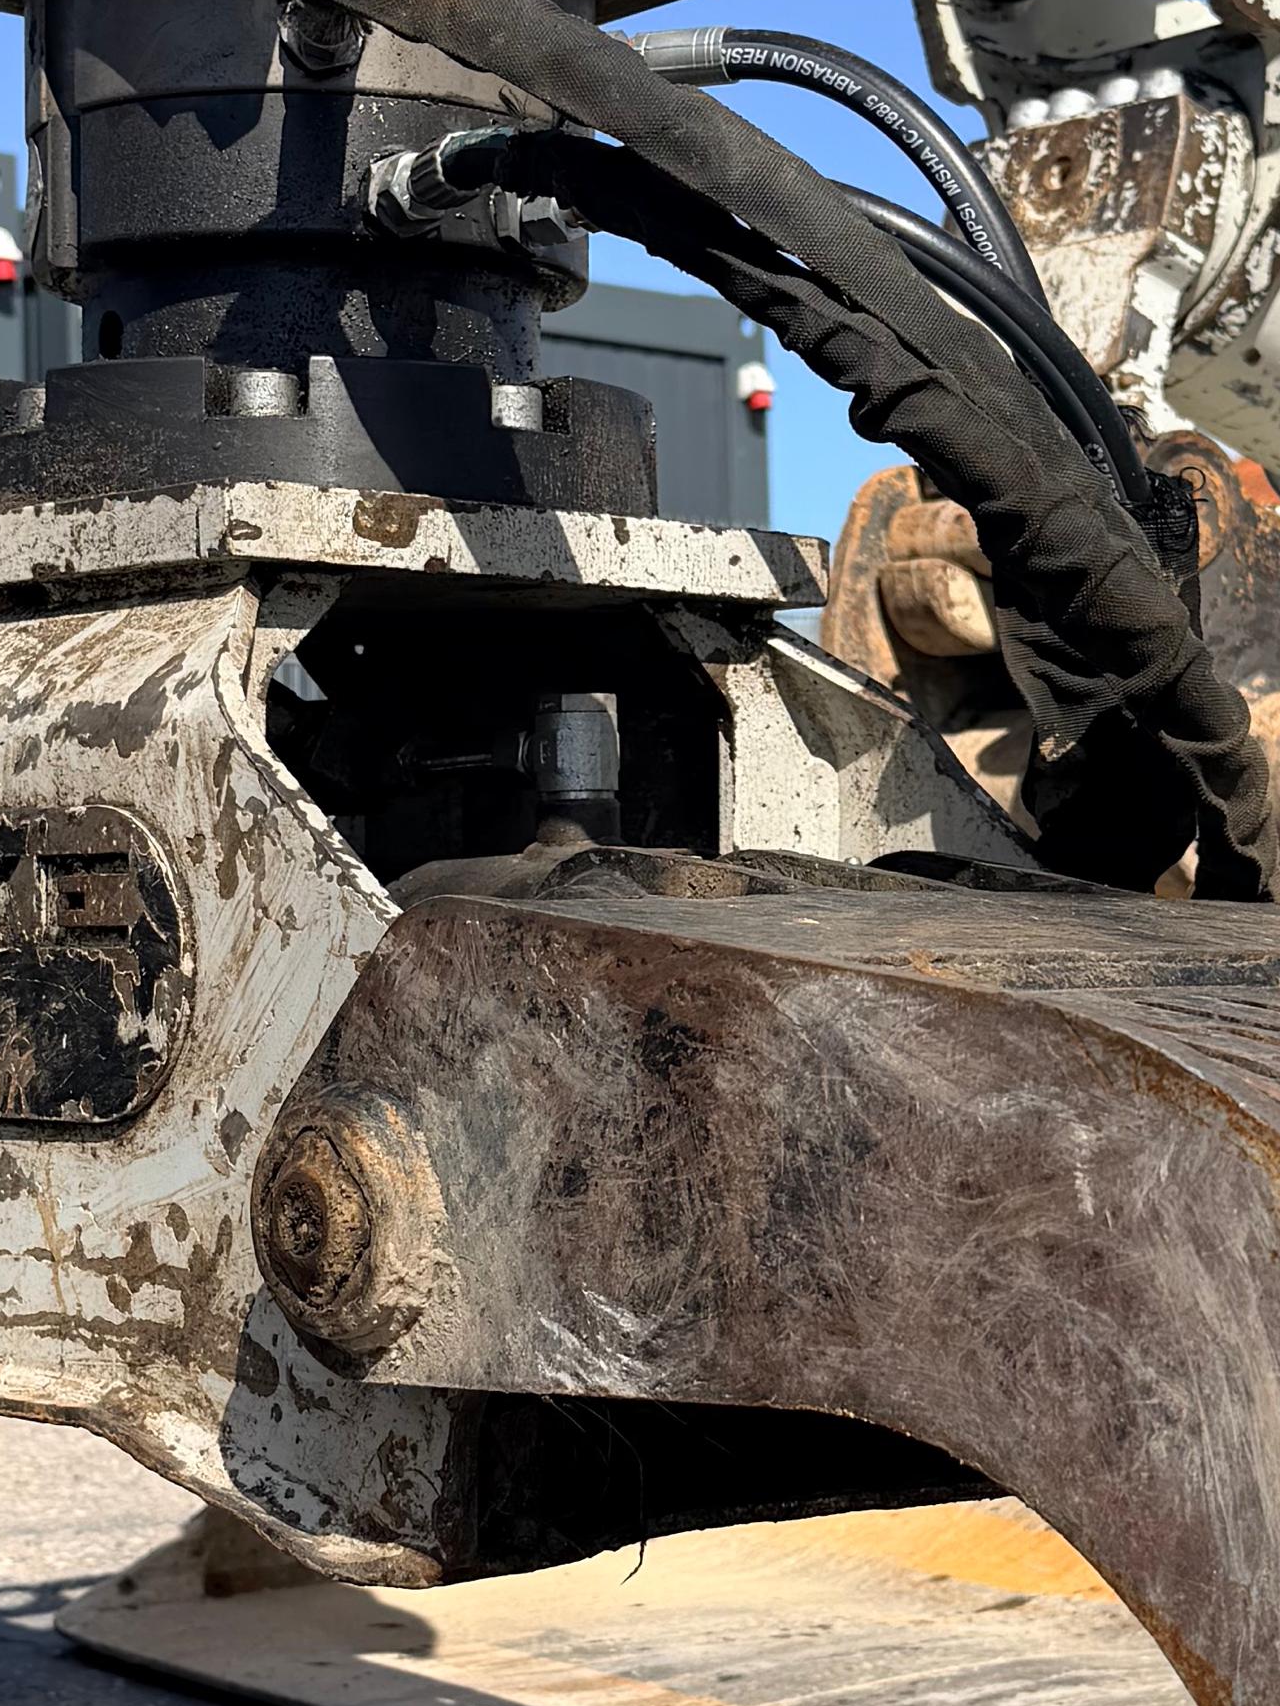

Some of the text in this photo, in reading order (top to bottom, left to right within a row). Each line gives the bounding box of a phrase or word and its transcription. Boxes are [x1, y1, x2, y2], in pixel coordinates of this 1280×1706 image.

[771, 50, 862, 98] ABRASION
[863, 94, 925, 150] IC-188/5
[918, 144, 962, 198] MSHA
